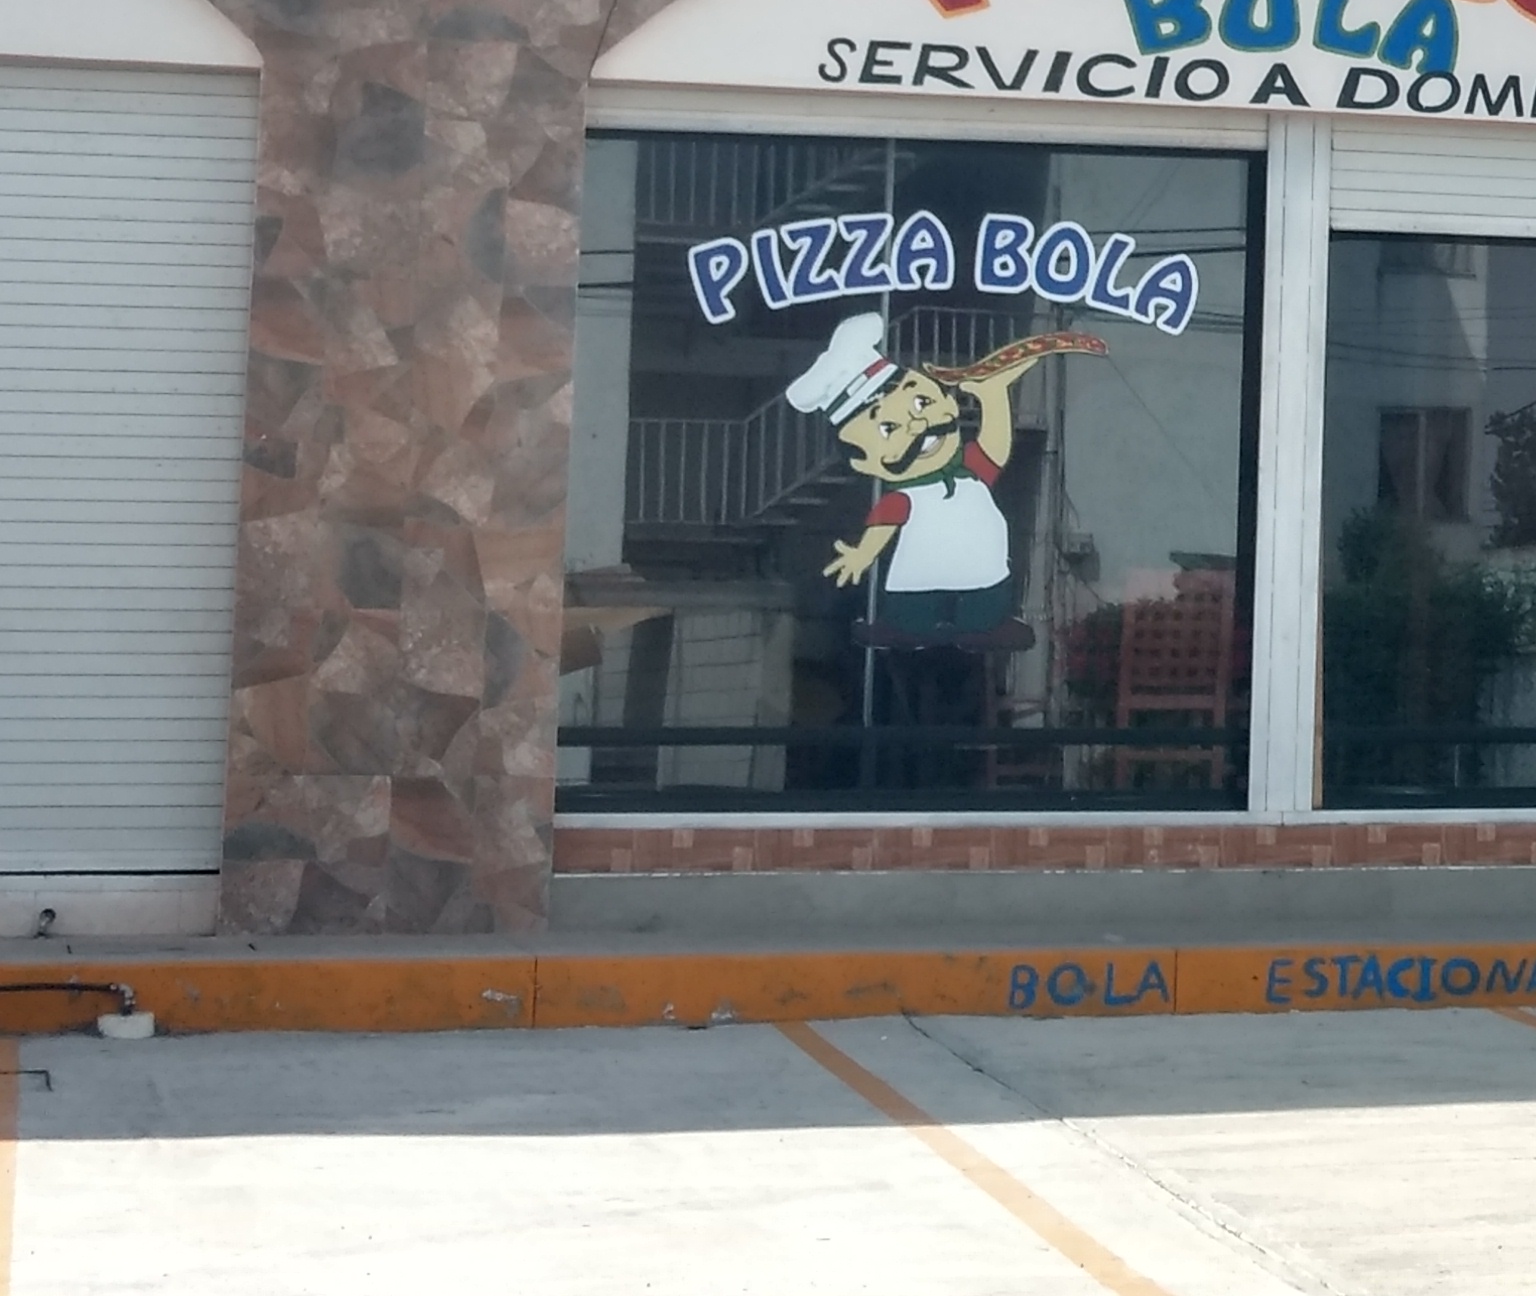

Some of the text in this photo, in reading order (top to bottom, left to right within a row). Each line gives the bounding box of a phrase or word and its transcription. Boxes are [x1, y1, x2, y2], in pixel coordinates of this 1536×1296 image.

[819, 36, 1230, 106] SERVICIO
[1249, 59, 1311, 108] A
[688, 211, 1199, 335] PIZZA BOLA
[1009, 960, 1170, 1010] BOLA
